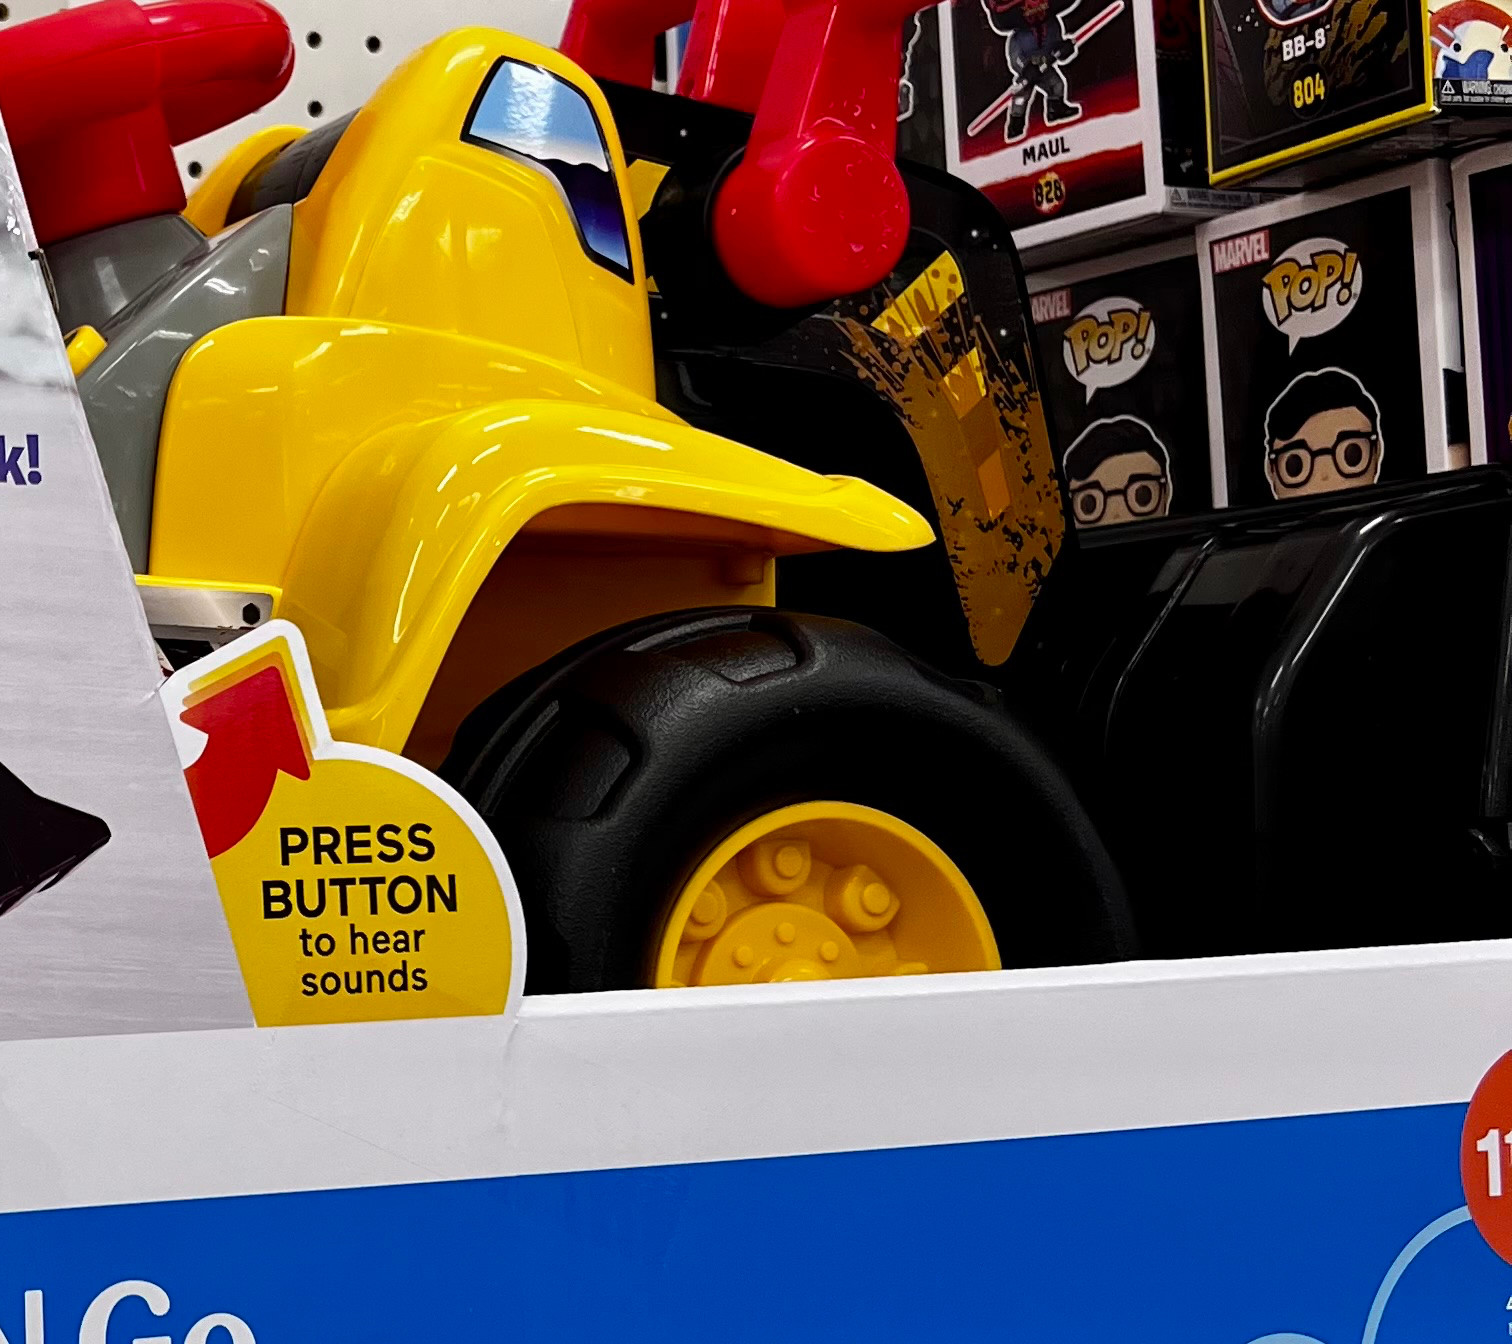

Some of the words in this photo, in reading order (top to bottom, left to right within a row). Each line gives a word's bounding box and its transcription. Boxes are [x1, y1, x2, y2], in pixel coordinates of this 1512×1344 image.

[1282, 26, 1328, 64] BB-8
[1293, 71, 1326, 109] 804
[1021, 136, 1071, 166] MAUL
[1034, 176, 1066, 205] 828
[1212, 233, 1270, 273] MARVEL
[1031, 292, 1072, 324] ARVEL
[1261, 251, 1357, 329] POP!
[1063, 307, 1152, 378] POP!
[279, 822, 436, 867] PRESS
[261, 873, 459, 920] BUTTON
[298, 928, 336, 958] to
[349, 923, 426, 955] hear
[301, 960, 429, 997] sounds
